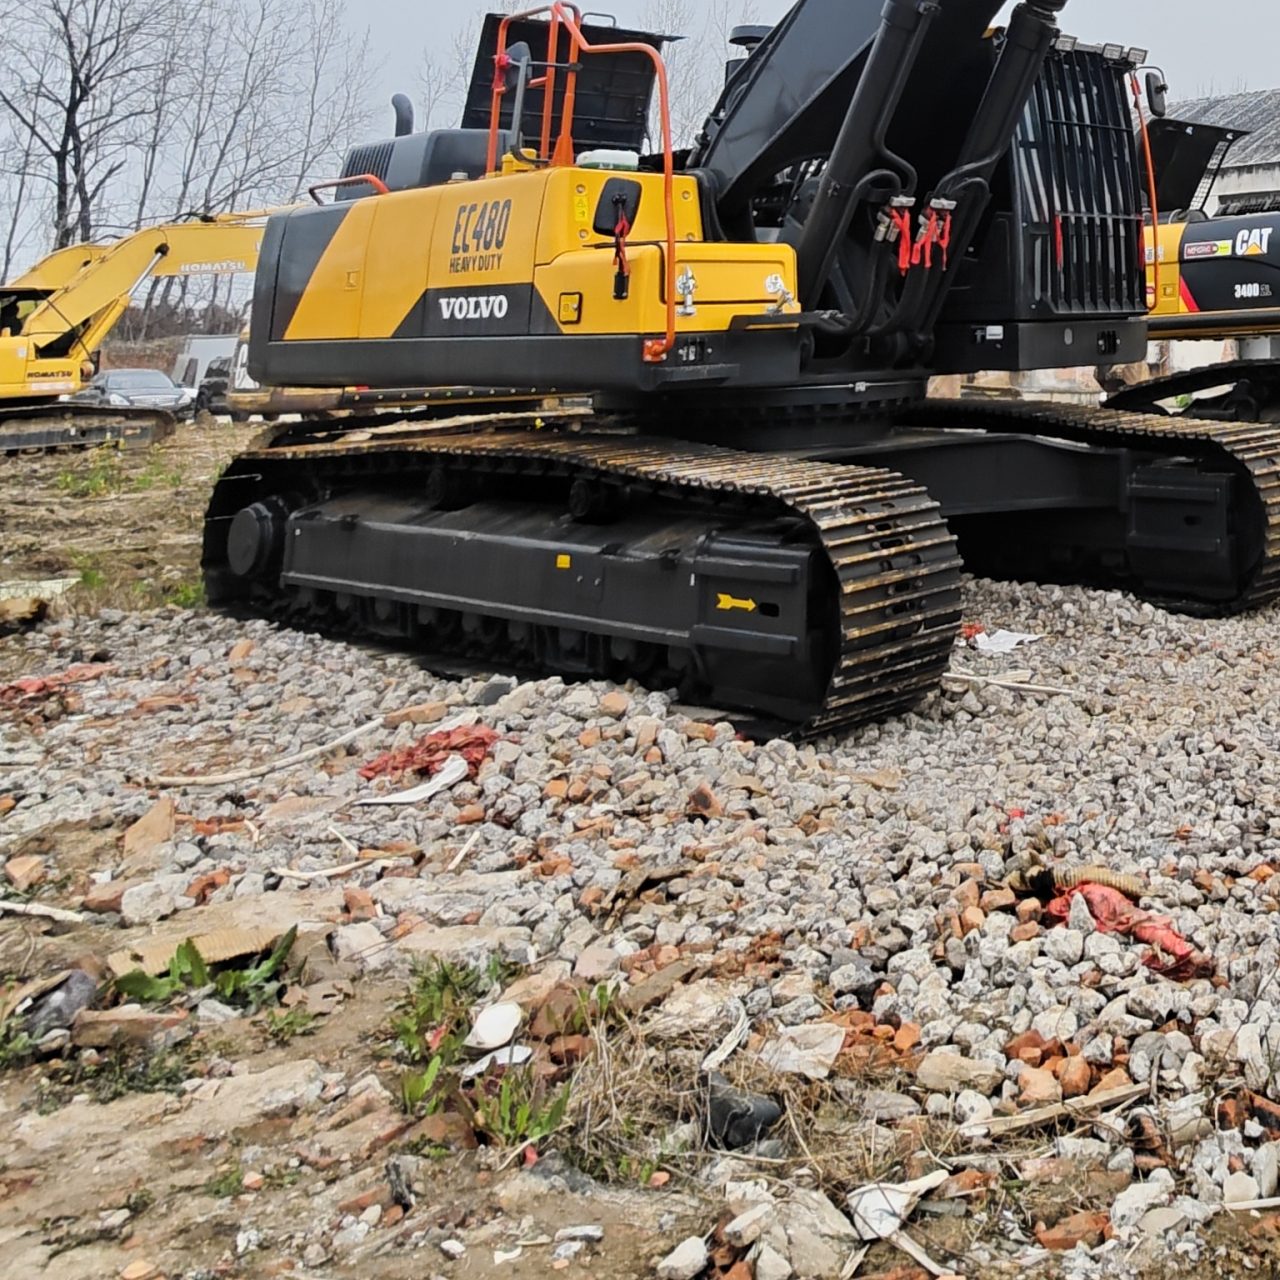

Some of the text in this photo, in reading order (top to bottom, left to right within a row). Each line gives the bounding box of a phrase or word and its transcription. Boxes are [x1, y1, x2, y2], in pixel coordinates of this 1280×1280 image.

[451, 199, 512, 254] EC480
[1235, 227, 1273, 256] CAT
[180, 261, 246, 272] KOMATSU
[449, 253, 503, 274] HEAVY DUTY
[438, 295, 508, 319] VOLVO
[27, 371, 73, 379] KOMATSU
